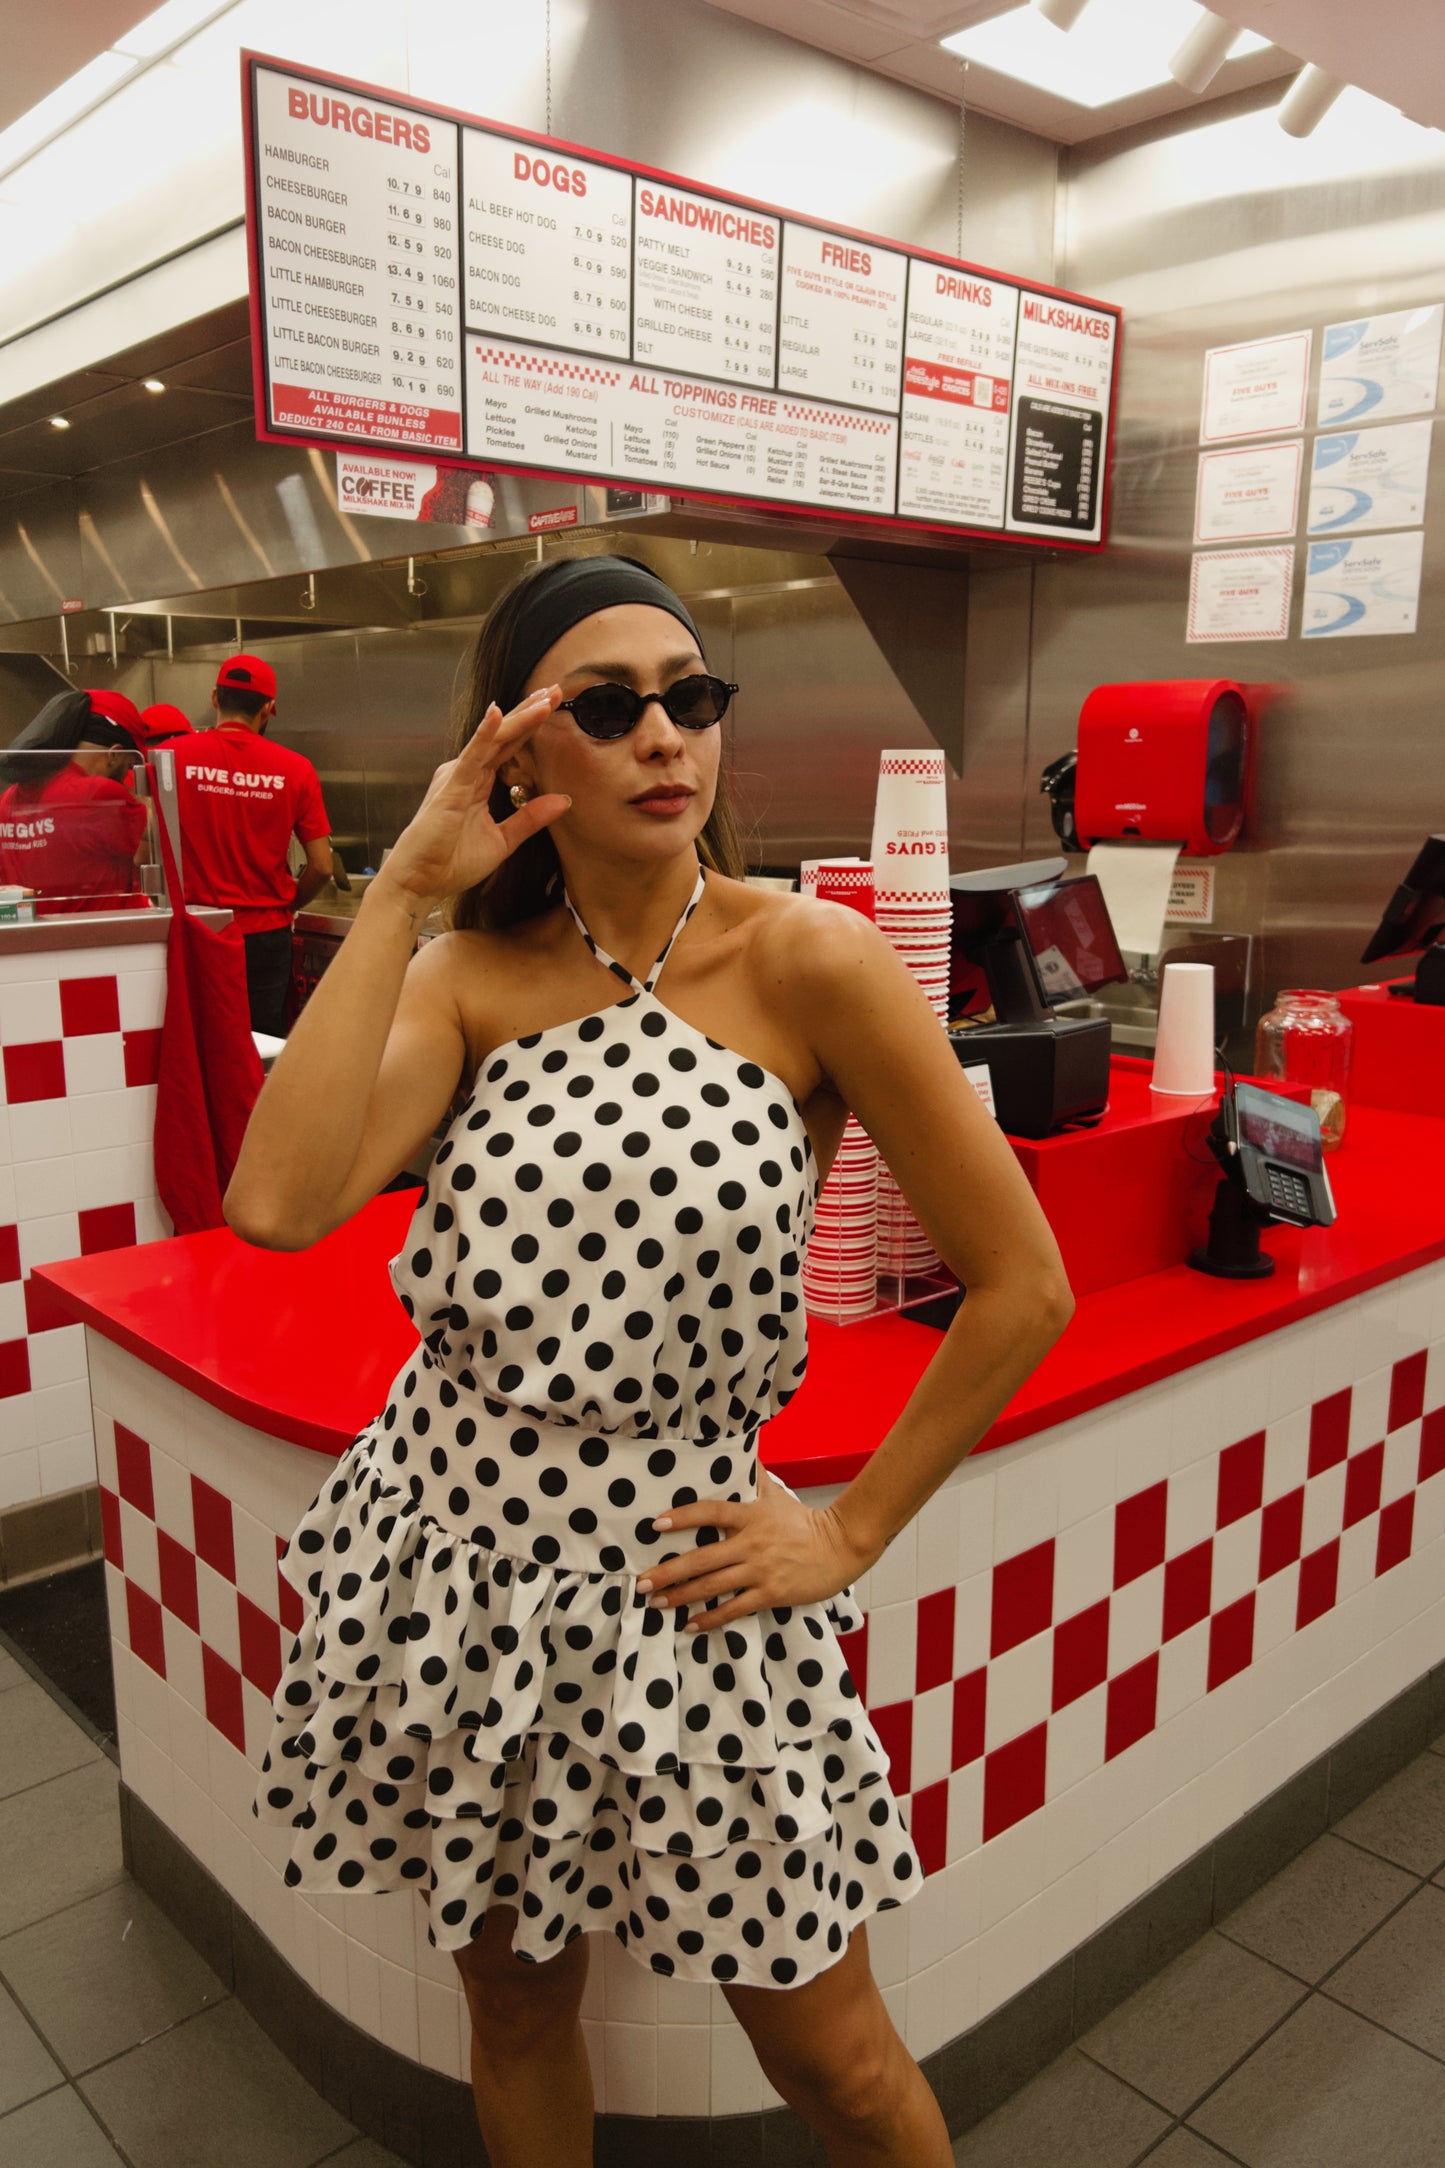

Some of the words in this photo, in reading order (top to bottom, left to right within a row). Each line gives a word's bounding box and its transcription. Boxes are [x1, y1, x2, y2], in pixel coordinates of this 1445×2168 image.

[288, 87, 431, 154] BURGERS
[265, 144, 330, 172] HAMBURGER
[433, 164, 450, 179] Cal
[514, 152, 587, 198] DOGS
[266, 175, 348, 206] CHEESEBURGER
[433, 188, 451, 203] 840
[267, 205, 303, 225] BACON
[305, 215, 346, 235] BURGER
[469, 198, 487, 213] ALL
[489, 203, 514, 219] BEEF
[516, 209, 534, 225] HOT
[537, 215, 557, 231] DOG
[612, 213, 626, 226] Cal
[640, 189, 775, 249] SANDWICHES
[433, 217, 451, 231] 980
[468, 231, 504, 250] CHEESE
[506, 240, 525, 255] DOG
[610, 235, 627, 249] 520
[638, 236, 665, 252] PATTY
[667, 243, 690, 259] MELT
[268, 236, 302, 255] BACON
[303, 244, 377, 271] CHEESEBURGER
[434, 245, 452, 260] 920
[821, 241, 872, 276] FRIES
[469, 266, 499, 283] BACON
[502, 273, 521, 287] DOG
[610, 266, 627, 279] 590
[638, 257, 668, 276] VEGGIE
[671, 265, 713, 285] SANDWICH
[270, 266, 302, 284] LITTLE
[304, 273, 365, 297] HAMBURGER
[432, 274, 455, 288] 1060
[936, 274, 992, 307] DRINKS
[271, 296, 302, 313] LITTLE
[304, 303, 378, 328] CHEESEBURGER
[435, 302, 453, 316] 540
[470, 299, 500, 315] BACON
[502, 305, 536, 323] CHEESE
[538, 314, 556, 328] DOG
[610, 299, 626, 312] 600
[654, 298, 676, 312] WITH
[678, 303, 713, 321] CHEESE
[782, 315, 809, 329] LITTLE
[1024, 300, 1110, 341] MILKSHAKES
[435, 329, 453, 342] 610
[609, 329, 626, 342] 670
[637, 317, 676, 335] GRILLED
[678, 326, 712, 343] CHEESE
[273, 326, 304, 343] LITTLE
[307, 333, 340, 350] BACON
[342, 339, 380, 357] BURGER
[637, 341, 654, 354] BLT
[782, 340, 820, 356] REGULAR
[274, 356, 299, 371] LITTLE
[300, 360, 326, 376] BACON
[326, 364, 382, 385] CHEESEBURGER
[436, 356, 454, 370] 620
[781, 365, 808, 379] LARGE
[437, 384, 455, 397] 690
[482, 370, 499, 385] ALL
[503, 375, 520, 388] THE
[523, 378, 542, 391] WAY
[543, 382, 564, 397] (Add
[566, 386, 580, 399] 190
[582, 388, 599, 402] Cal)
[1231, 385, 1252, 396] FIVE
[1254, 381, 1278, 393] GUYS
[630, 374, 659, 395] ALL
[663, 380, 737, 409] TOPPINGS
[741, 394, 778, 417] FREE
[308, 391, 330, 402] ALL
[333, 394, 386, 411] BURGERS
[389, 404, 397, 412] &
[400, 404, 430, 417] DOGS
[485, 397, 507, 409] Mayo
[524, 405, 550, 417] Grilled
[552, 409, 598, 424] Mushrooms
[313, 405, 374, 422] AVAILABLE
[377, 414, 426, 430] BUNLESS
[665, 418, 678, 427] Cal
[673, 405, 735, 424] CUSTOMIZE
[279, 412, 323, 427] DEDUCT
[325, 420, 344, 431] 240
[346, 423, 368, 434] CAL
[370, 426, 400, 439] FROM
[402, 431, 432, 444] BASIC
[434, 436, 457, 447] ITEM
[485, 412, 516, 425] Lettuce
[565, 425, 598, 438] Ketchup
[624, 423, 643, 434] Mayo
[486, 425, 515, 437] Pickles
[543, 435, 569, 446] Grilled
[571, 439, 598, 450] Onions
[624, 434, 651, 445] Lettuce
[696, 436, 716, 446] Green
[718, 440, 745, 451] Peppers
[486, 437, 525, 450] Tomatoes
[565, 449, 597, 461] Mustard
[624, 444, 650, 455] Pickles
[696, 446, 717, 456] Grilled
[719, 450, 741, 460] Onions
[768, 447, 793, 458] Ketchup
[624, 455, 658, 467] Tomatoes
[696, 459, 708, 467] Hot
[710, 460, 730, 470] Sauce
[768, 456, 793, 467] Mustard
[840, 459, 873, 470] Mushrooms
[342, 463, 391, 478] AVAILABLE
[392, 470, 416, 481] NOW!
[767, 466, 788, 475] Onions
[342, 476, 415, 502] COFFEE
[1224, 489, 1243, 499] FIVE
[1245, 487, 1270, 497] GUYS
[343, 495, 388, 507] MILKSHAKE
[390, 500, 415, 510] MIX-IN
[185, 765, 229, 784] FIVE
[232, 772, 285, 790] GUYS
[197, 784, 235, 795] BURGERS
[250, 791, 273, 799] FRIES
[897, 830, 919, 838] FRIES
[886, 842, 936, 855] GUYS
